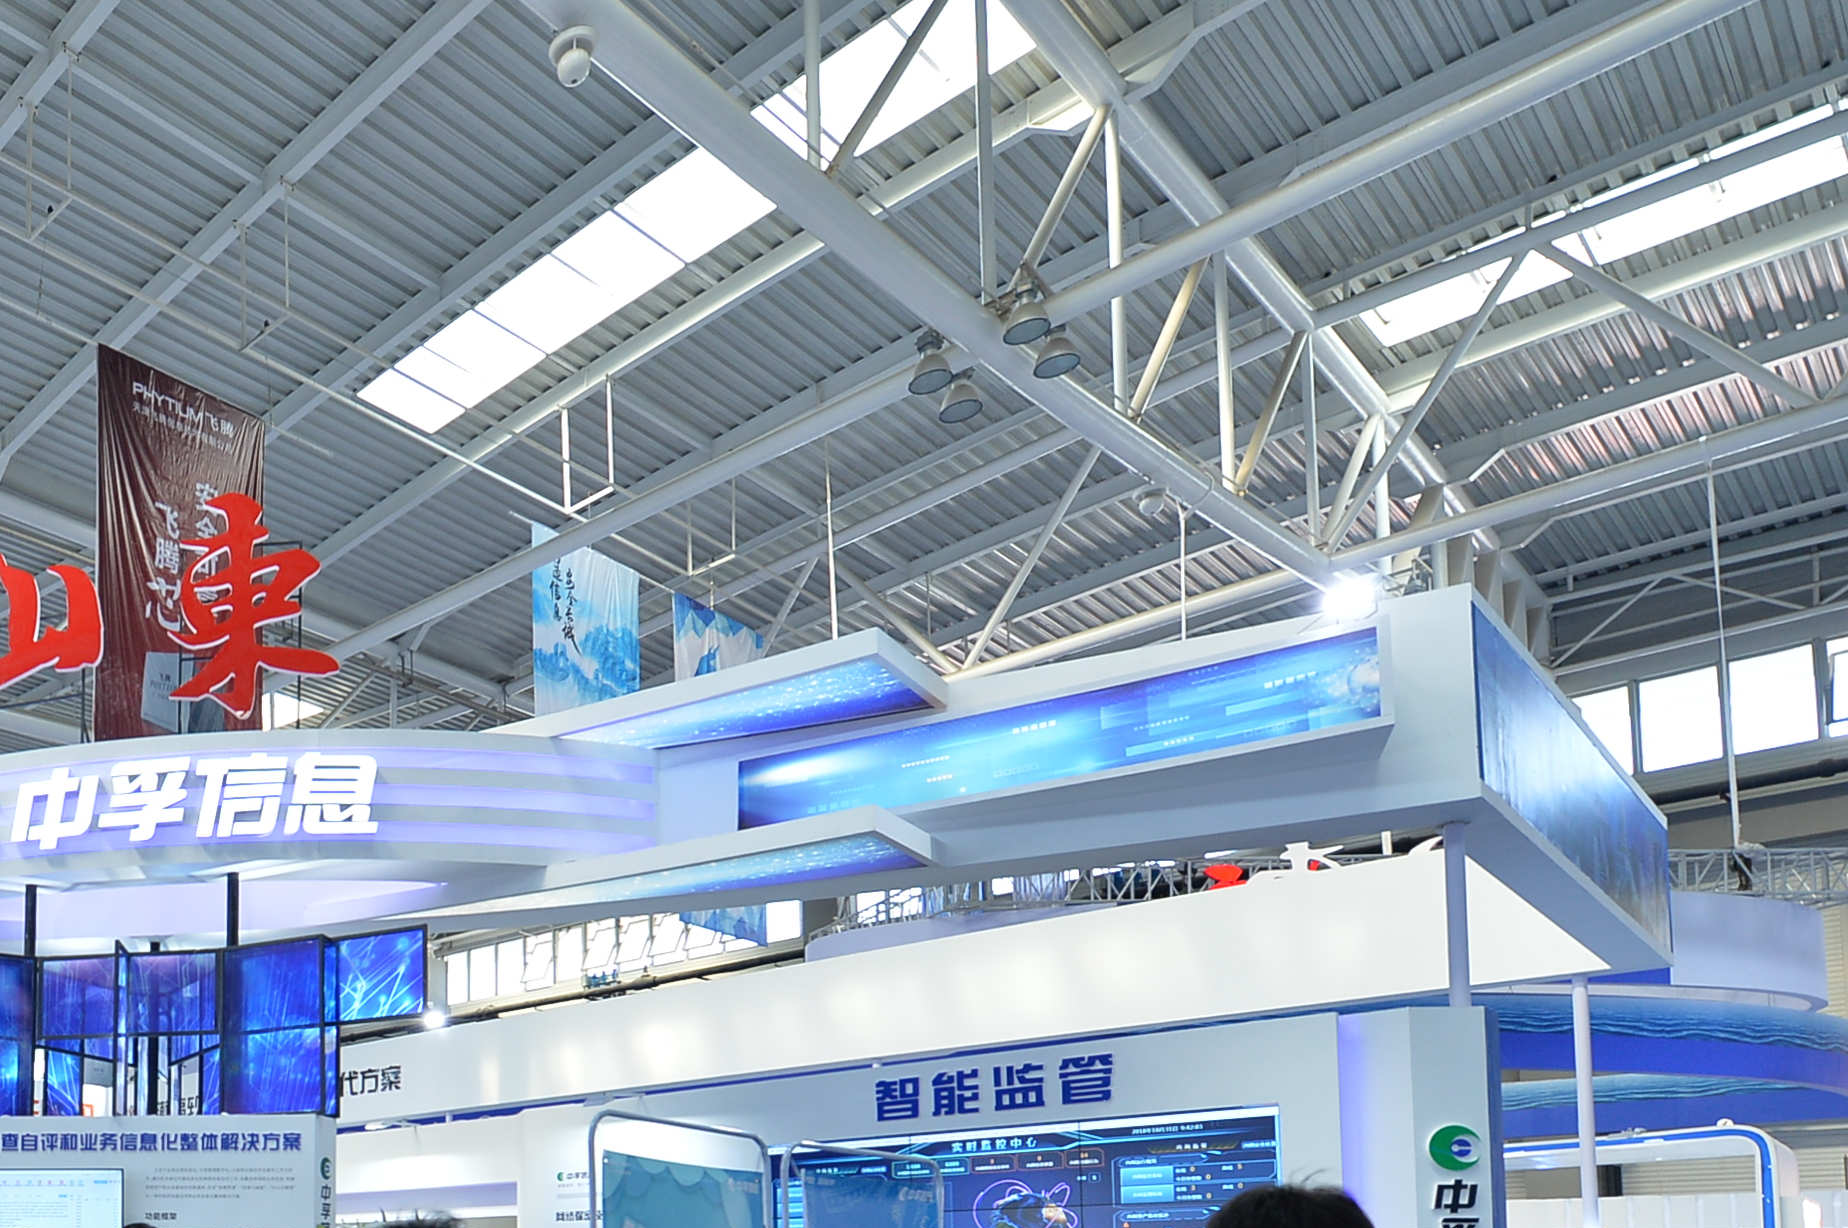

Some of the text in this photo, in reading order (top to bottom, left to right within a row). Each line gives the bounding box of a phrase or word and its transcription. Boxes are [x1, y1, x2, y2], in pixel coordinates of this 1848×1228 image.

[10, 751, 380, 850] 中孚信息
[875, 1052, 1115, 1123] 智能监管
